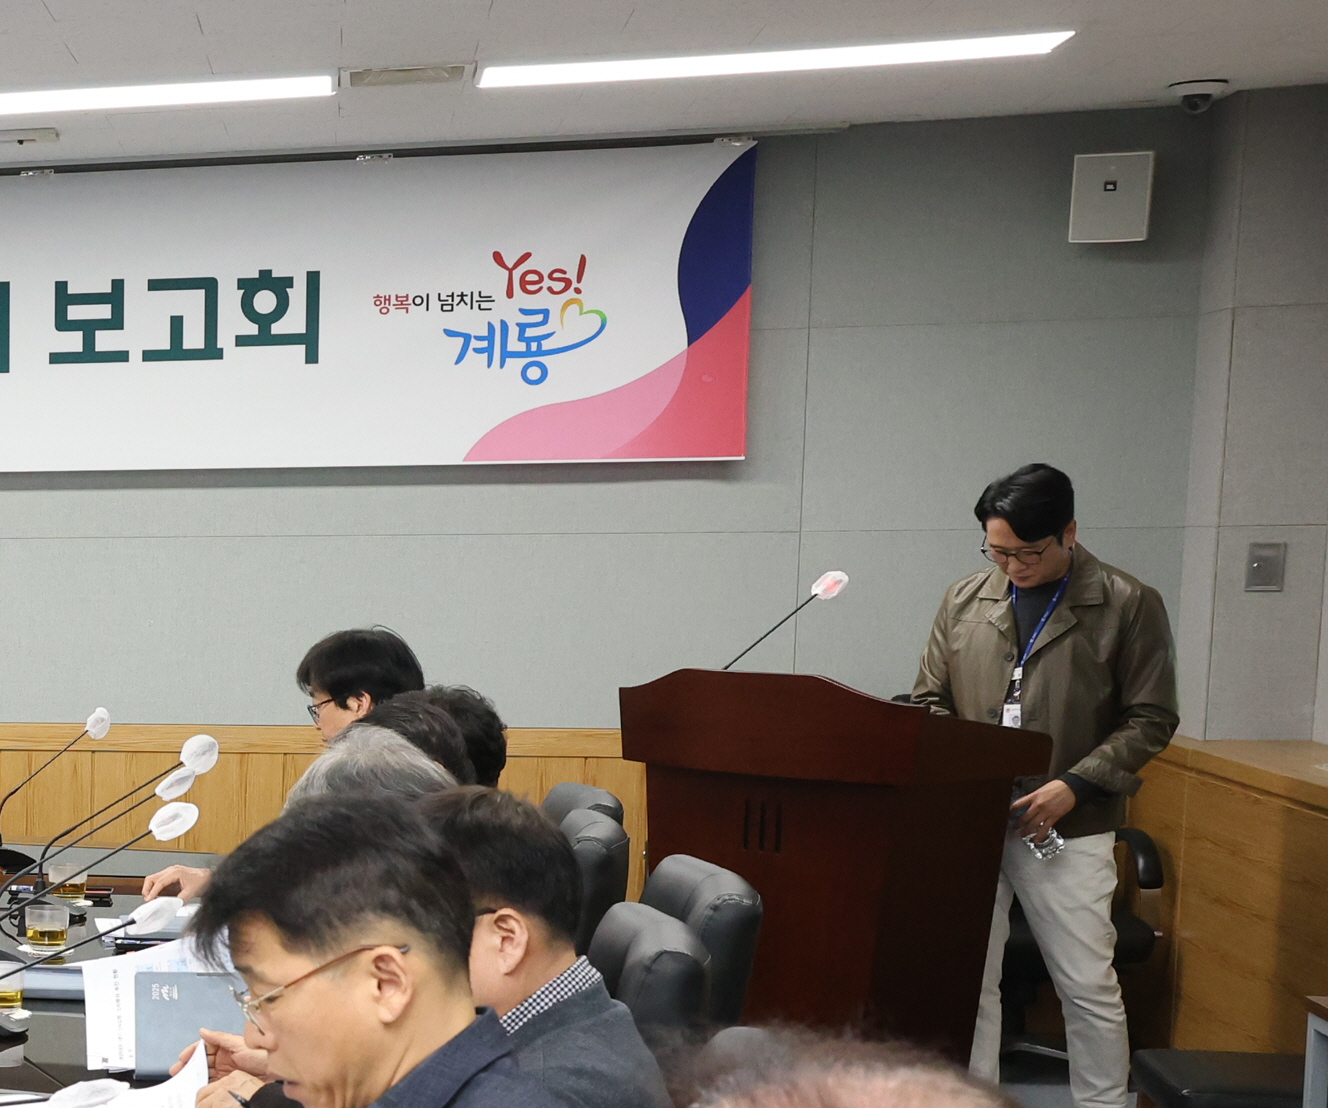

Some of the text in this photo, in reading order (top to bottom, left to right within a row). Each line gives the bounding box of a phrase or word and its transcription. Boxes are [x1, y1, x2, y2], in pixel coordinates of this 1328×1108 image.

[373, 290, 496, 315] 행복이 넘치는
[492, 250, 587, 299] Yes!
[48, 269, 321, 366] 보고회
[442, 307, 559, 386] 계룡
